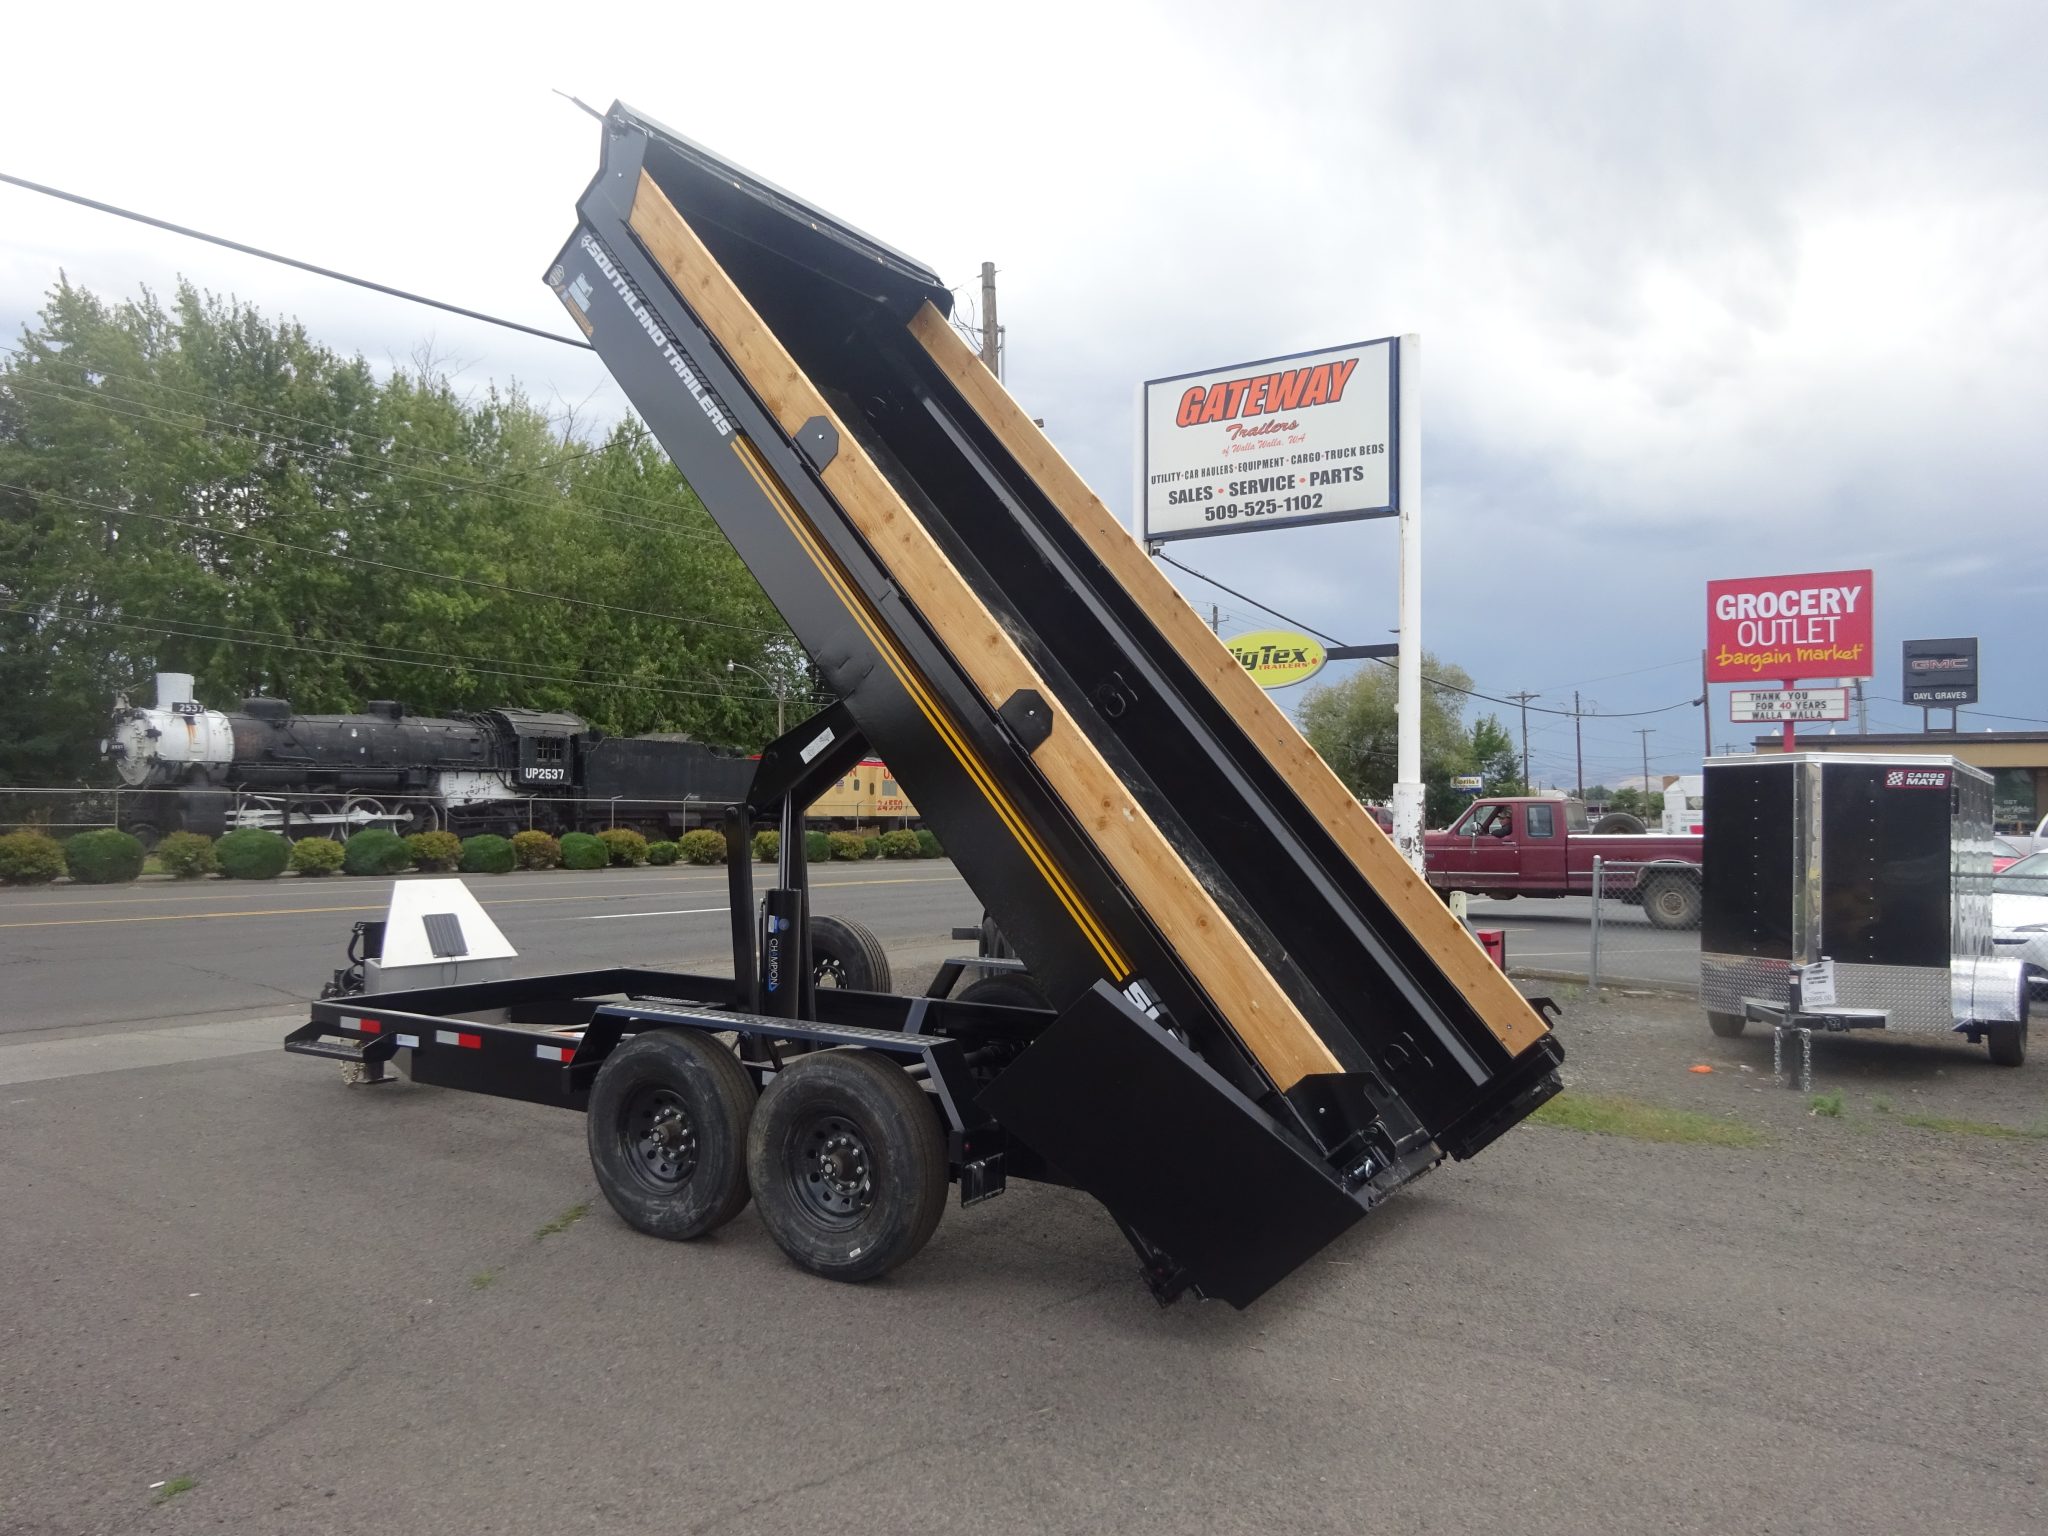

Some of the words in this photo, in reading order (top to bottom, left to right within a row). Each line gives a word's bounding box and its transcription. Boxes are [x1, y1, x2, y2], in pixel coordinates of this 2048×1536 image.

[586, 240, 667, 347] SOUTHLAND
[663, 344, 732, 436] TRAILERS
[1176, 358, 1359, 428] GATEWAY
[1226, 419, 1299, 440] Trailers
[1222, 446, 1229, 456] of
[1232, 441, 1255, 453] Walla
[1151, 472, 1181, 485] UTILITY
[1184, 469, 1199, 480] CAR
[1201, 464, 1234, 477] HAULERS
[1238, 457, 1284, 472] EQUIPMENT
[1291, 452, 1320, 465] CARGO
[1325, 447, 1357, 460] TRUCK
[1360, 443, 1384, 456] BEDS
[1168, 485, 1213, 505] SALES
[1228, 474, 1295, 497] SERVICE
[1309, 465, 1364, 487] PARTS
[1205, 493, 1323, 521] 509-525-1102
[1715, 586, 1861, 621] GROCERY
[1737, 616, 1841, 647] OUTLET
[1258, 662, 1308, 670] TRAILERS
[1715, 644, 1792, 672] bargain
[1797, 644, 1862, 662] market
[1912, 658, 1968, 670] GMC
[1755, 702, 1774, 710] FOR
[1779, 702, 1792, 710] 40
[1796, 701, 1827, 709] YEARS
[1788, 692, 1808, 700] YOU
[1913, 692, 1932, 700] DAYL
[1935, 691, 1967, 699] GRAVES
[180, 703, 204, 712] 2537
[1752, 711, 1782, 719] WALLA
[1790, 711, 1822, 719] WALLA
[525, 767, 564, 780] UP2537
[770, 938, 778, 985] CHAMPION
